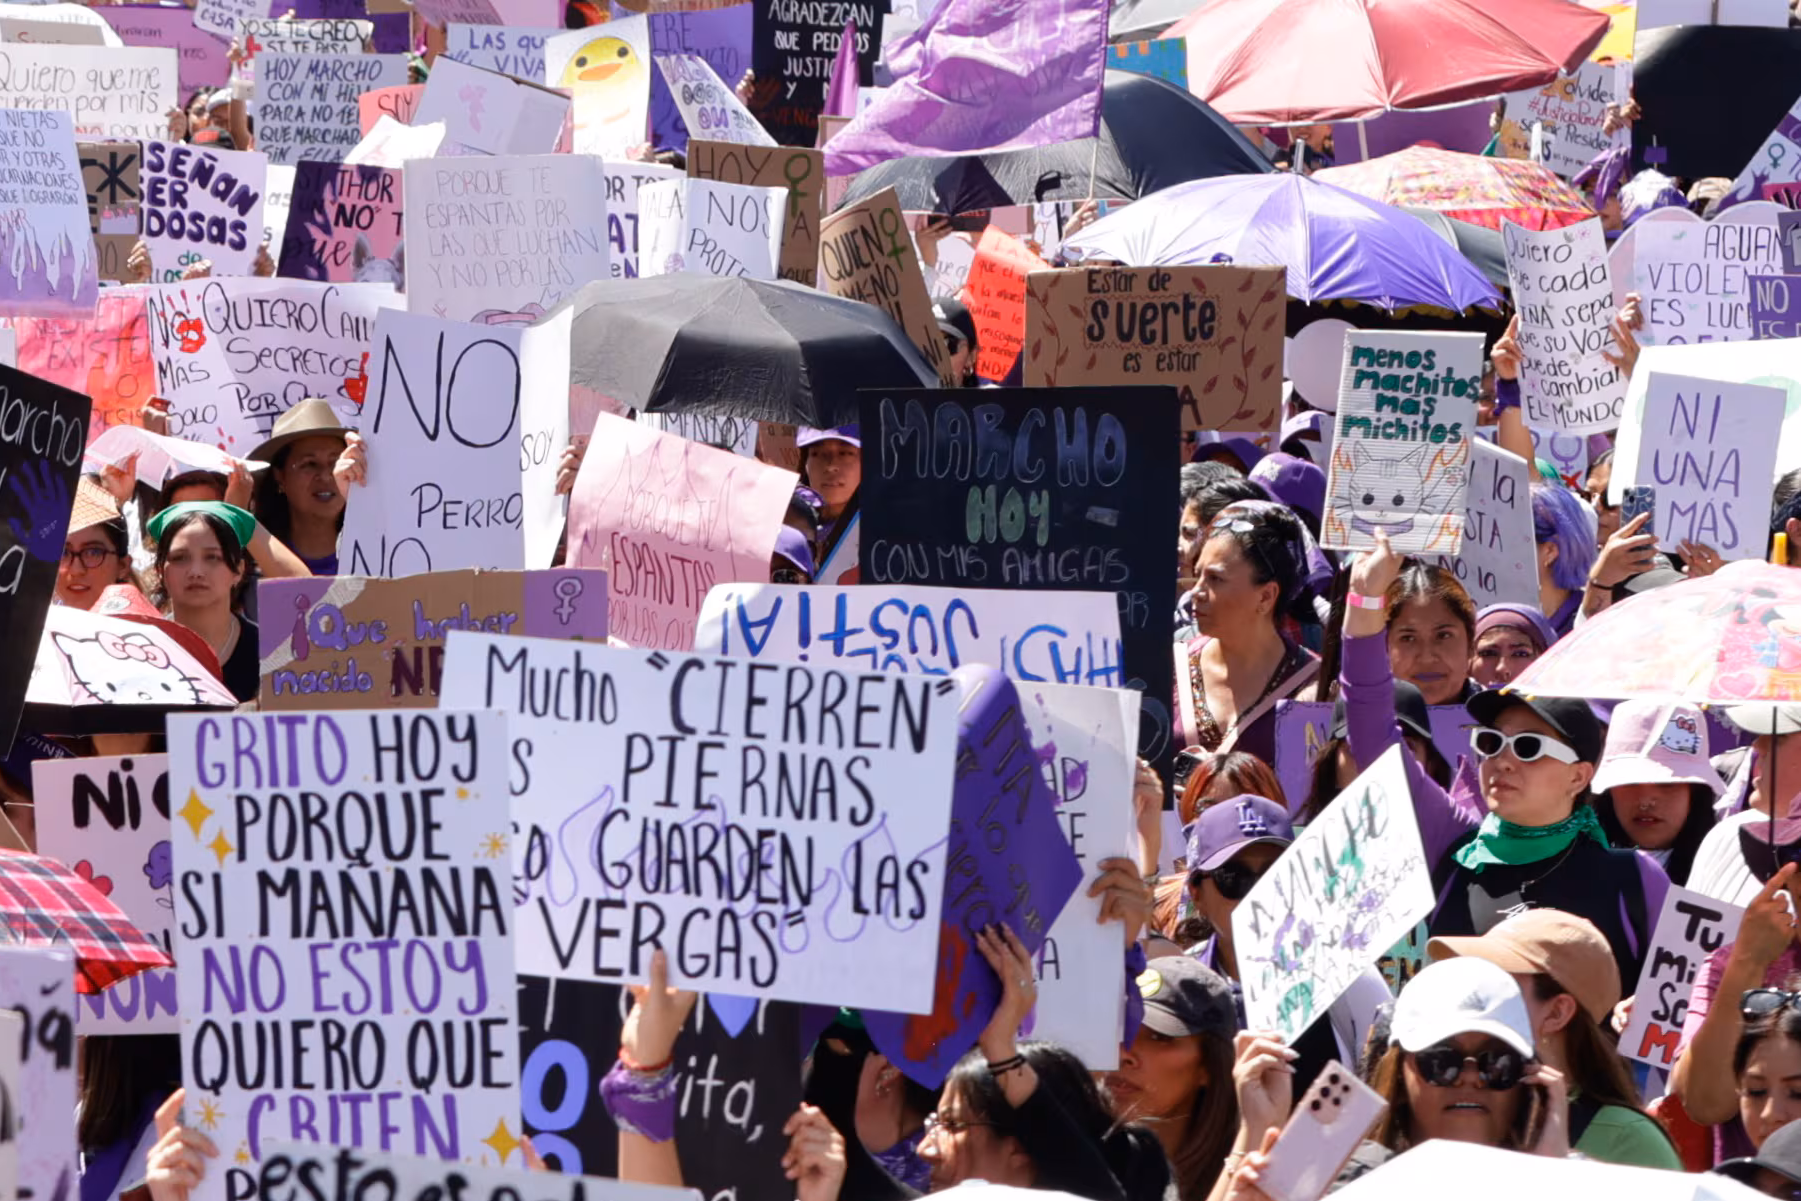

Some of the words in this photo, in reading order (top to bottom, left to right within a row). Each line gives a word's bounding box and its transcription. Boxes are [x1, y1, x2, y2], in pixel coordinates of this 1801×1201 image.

[265, 58, 301, 81] HOY
[306, 60, 383, 82] MARCHO
[6, 112, 59, 129] NIETAS
[259, 104, 306, 123] PARA
[311, 105, 333, 123] NO
[426, 201, 526, 228] ESPANTAS
[535, 199, 572, 226] POR
[1148, 273, 1171, 293] de
[1123, 351, 1142, 373] es
[1156, 349, 1201, 373] estar
[1353, 367, 1481, 403] machitos
[373, 331, 521, 448] NO
[879, 397, 1127, 487] MARCHO
[1342, 415, 1463, 443] michitos
[1669, 392, 1722, 445] NI
[1654, 448, 1740, 499] UNA
[966, 484, 1050, 546] HOY
[871, 539, 930, 583] CON
[1002, 546, 1129, 585] AMIGAS
[485, 644, 619, 726] Mucho
[195, 715, 349, 789] GRITO
[370, 714, 479, 784] HOY
[622, 734, 876, 828] PIERNAS
[234, 789, 451, 869] PORQUE
[1236, 802, 1266, 832] LA
[599, 808, 815, 907] GUARDEN
[852, 841, 930, 921] LAS
[181, 870, 224, 940] SI
[258, 861, 508, 939] MAÑANA
[203, 945, 287, 1014] NO
[310, 940, 489, 1015] ESTOY
[193, 1019, 387, 1096] QUIERO
[407, 1019, 513, 1094] QUE
